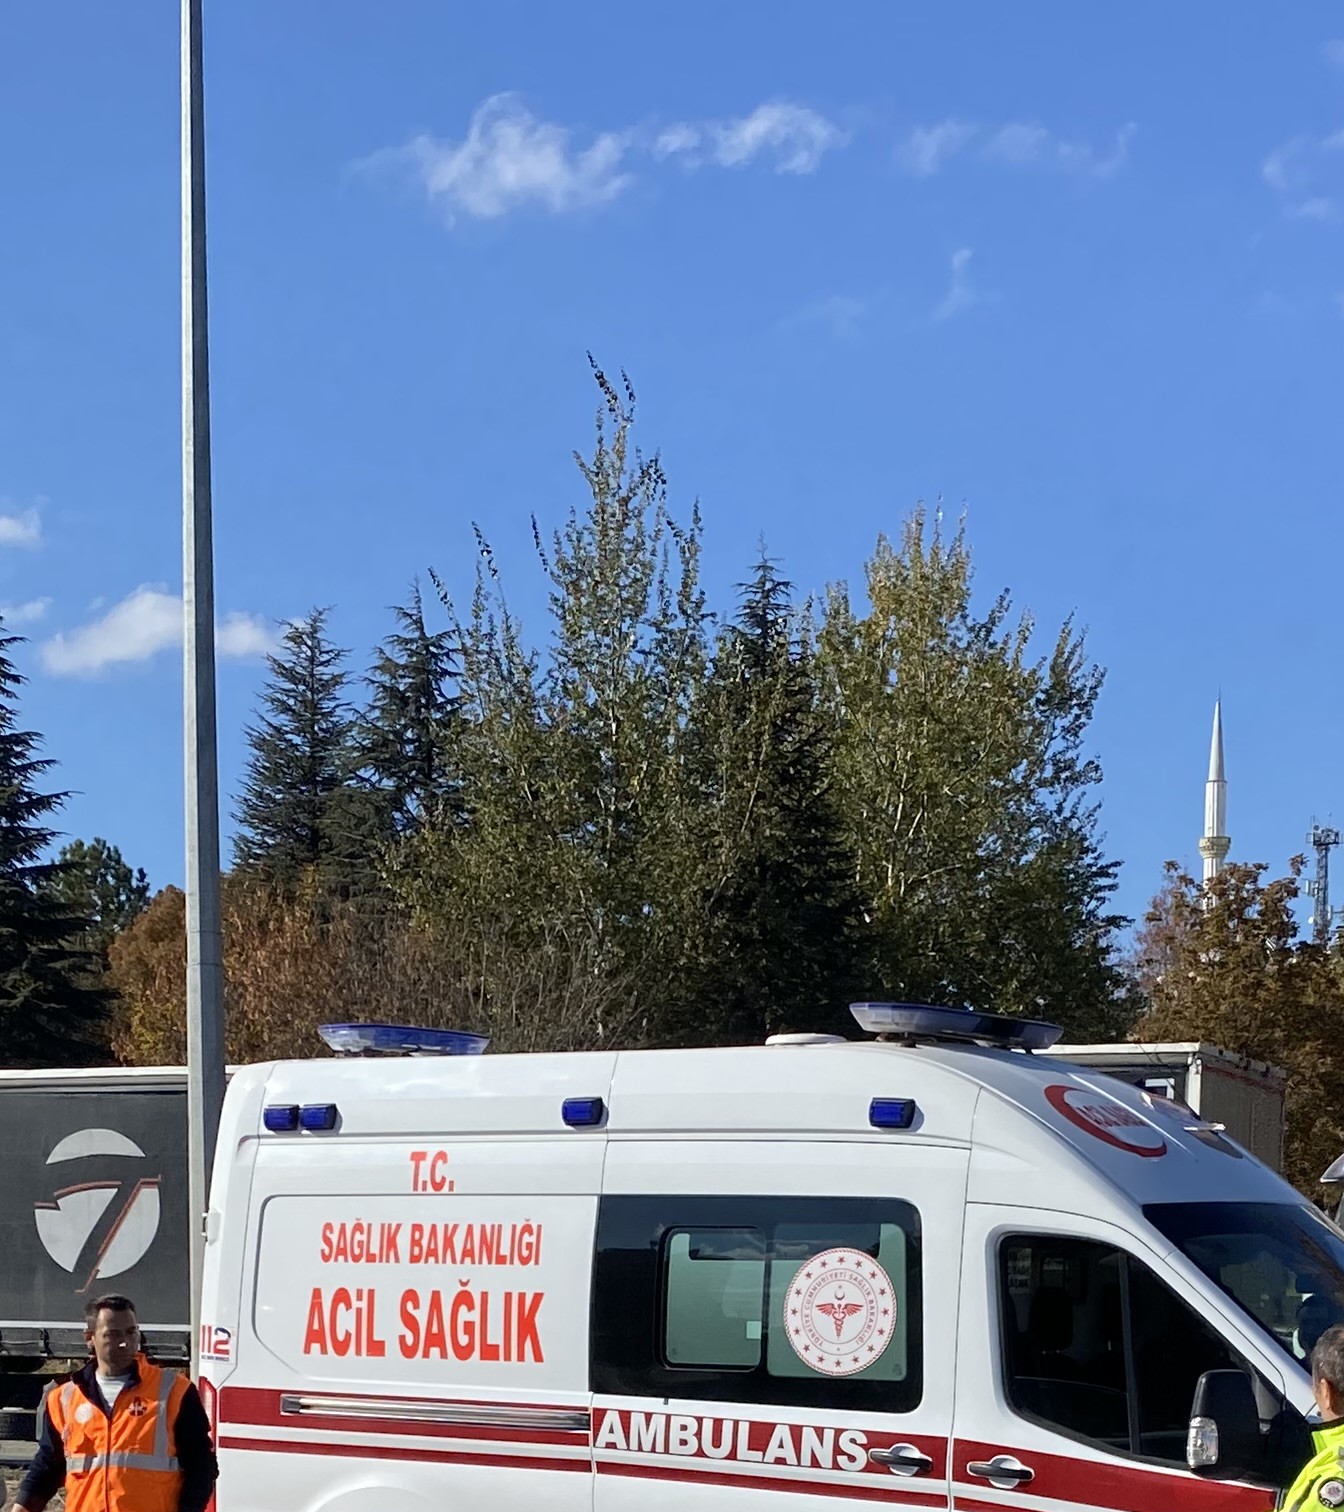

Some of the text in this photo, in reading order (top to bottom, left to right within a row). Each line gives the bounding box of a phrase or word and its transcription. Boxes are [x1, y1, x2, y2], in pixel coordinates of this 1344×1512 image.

[409, 1150, 455, 1192] T.C.
[320, 1217, 543, 1266] SAĞLIK BAKANLIĞI
[201, 1325, 232, 1355] 112
[398, 1278, 545, 1363] SAĞLIK
[594, 1409, 868, 1472] AMBULANS
